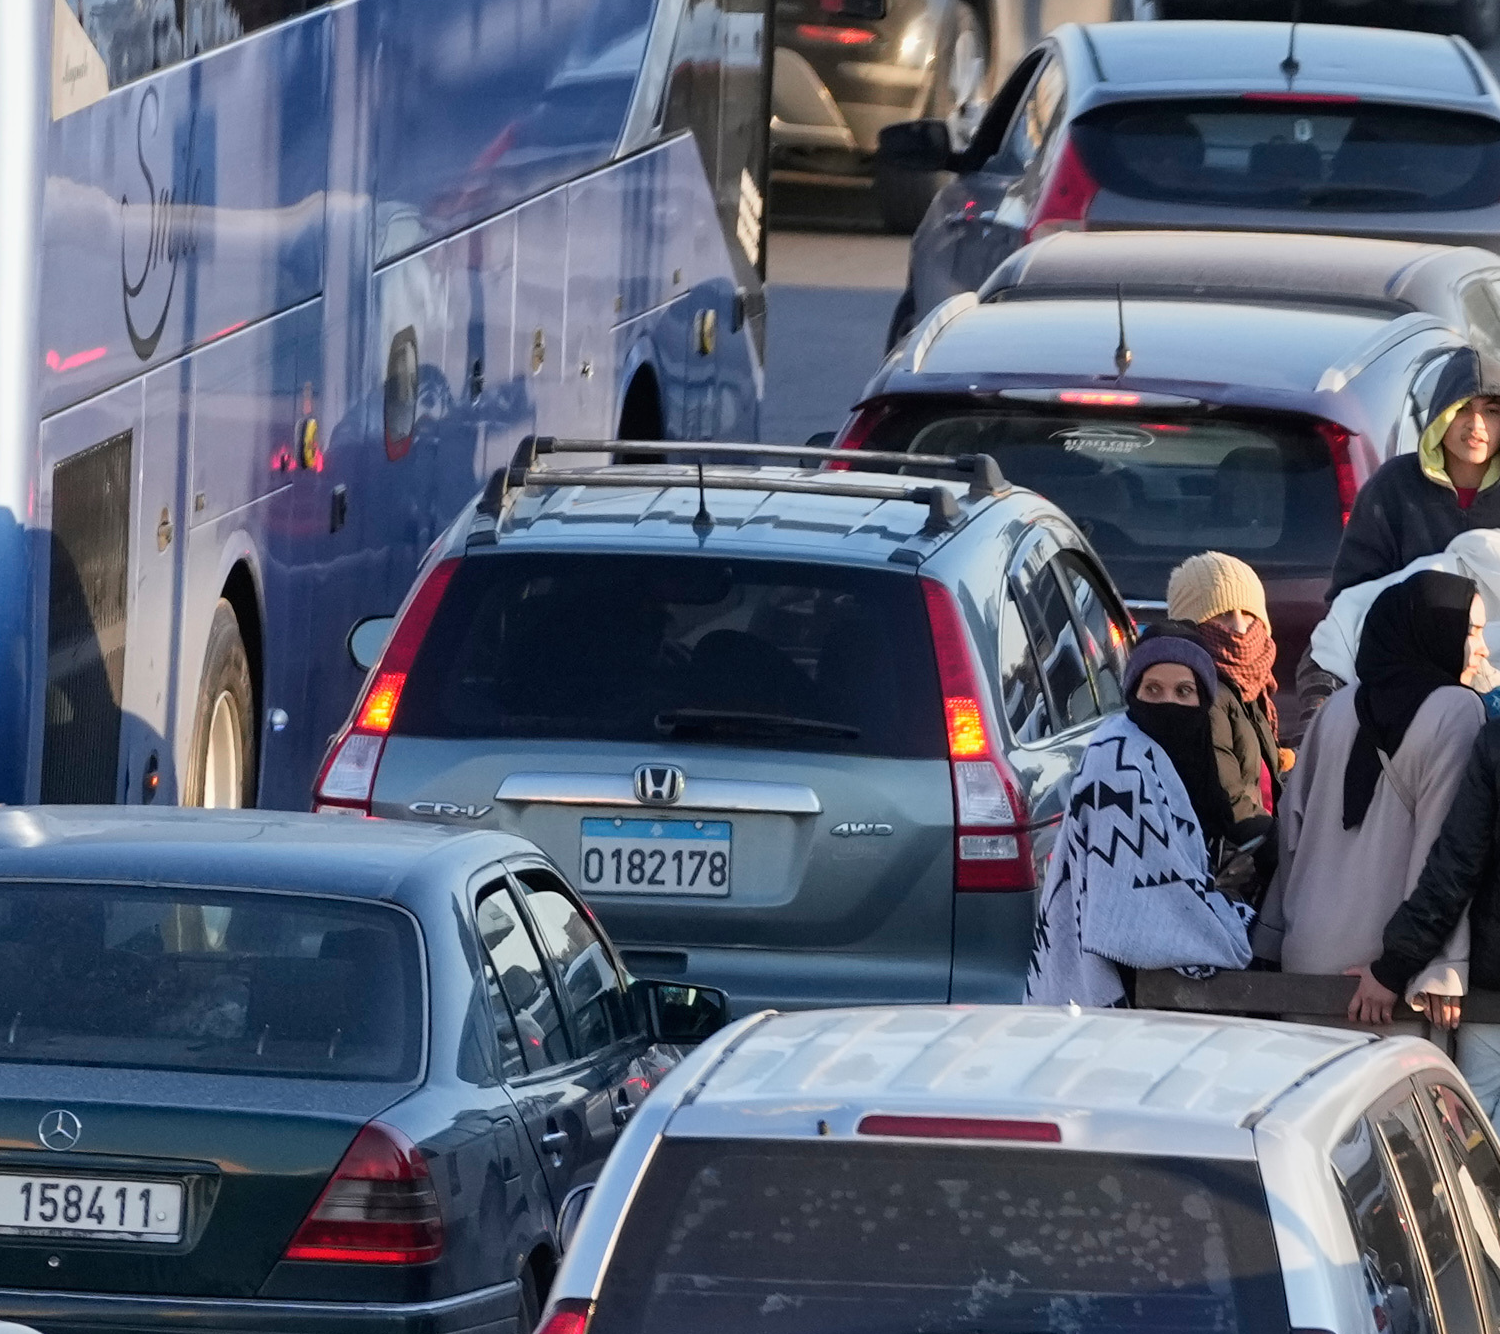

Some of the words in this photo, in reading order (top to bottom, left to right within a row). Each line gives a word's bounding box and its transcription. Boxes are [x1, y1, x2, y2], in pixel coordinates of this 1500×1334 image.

[408, 801, 493, 819] CR-V
[830, 822, 894, 838] 4WD
[20, 1181, 153, 1229] 158411
